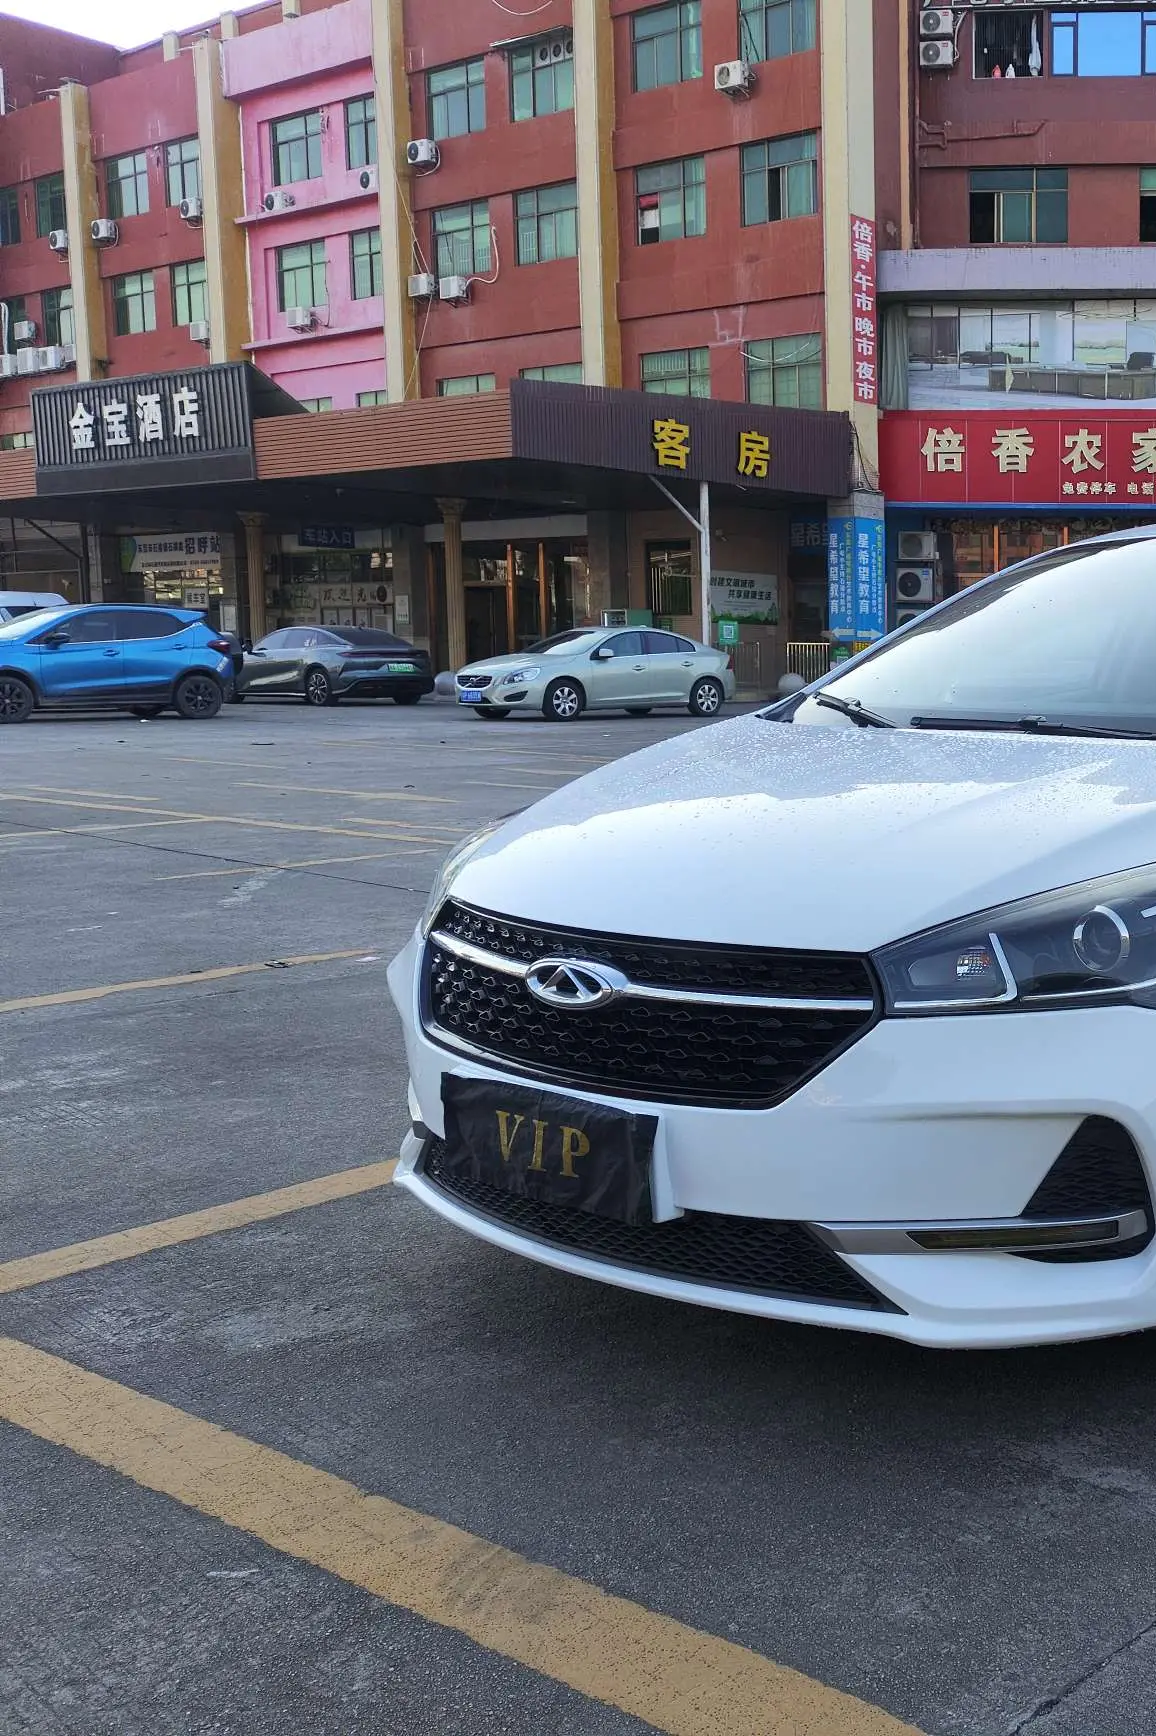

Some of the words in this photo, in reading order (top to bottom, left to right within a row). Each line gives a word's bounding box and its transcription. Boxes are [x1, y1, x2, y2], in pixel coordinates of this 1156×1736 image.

[69, 386, 199, 450] 金宝酒店
[651, 418, 771, 479] 客房
[1062, 481, 1117, 495] 免费停车
[857, 533, 870, 615] 星希望教育
[494, 1109, 591, 1179] VIP
